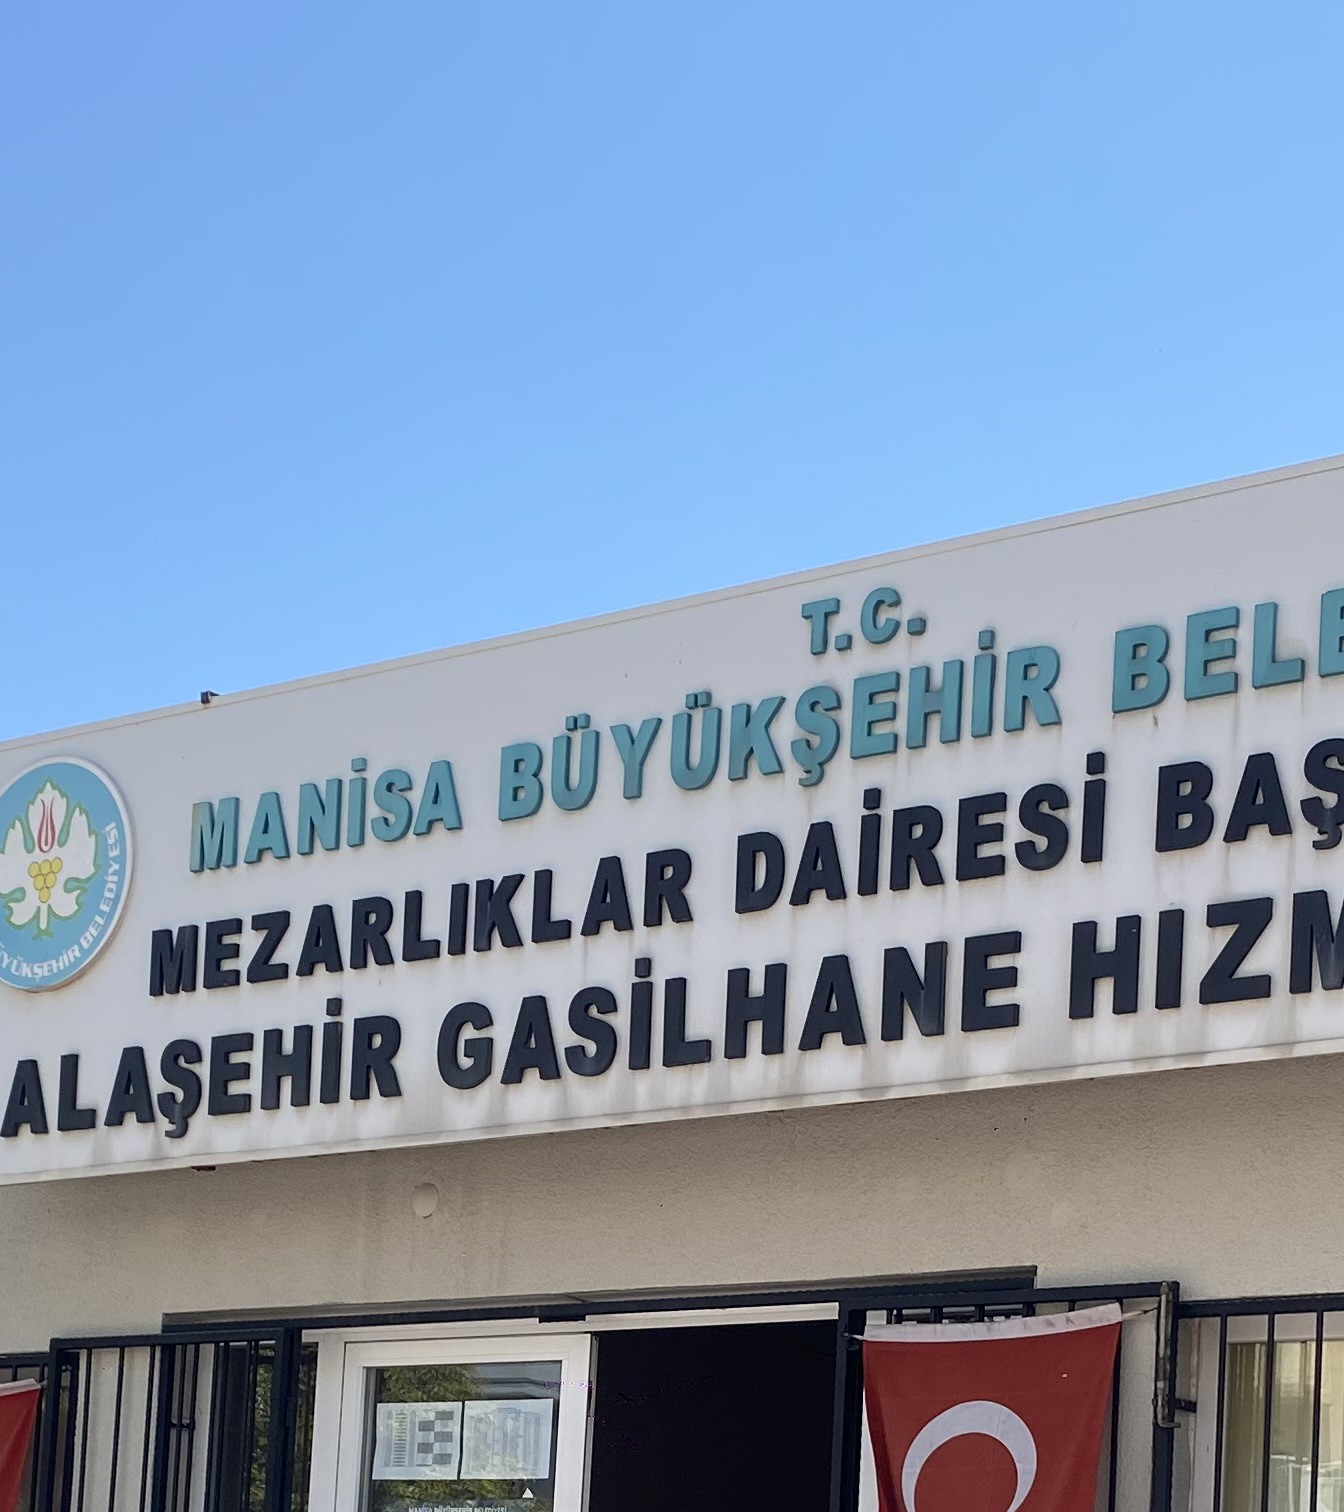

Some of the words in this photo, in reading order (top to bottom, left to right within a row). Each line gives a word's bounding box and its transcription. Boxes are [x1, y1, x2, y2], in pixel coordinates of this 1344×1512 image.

[801, 587, 926, 656] T.C.
[190, 757, 462, 873] MANİSA
[498, 629, 1061, 822] BÜYÜKŞEHİR
[80, 821, 120, 950] BELEDİYESİ
[149, 848, 693, 997] MEZARLIKLAR
[734, 751, 1106, 914] DAİRESİ
[0, 997, 402, 1139] ALAŞEHİR
[436, 931, 1022, 1090] GASİLHANE
